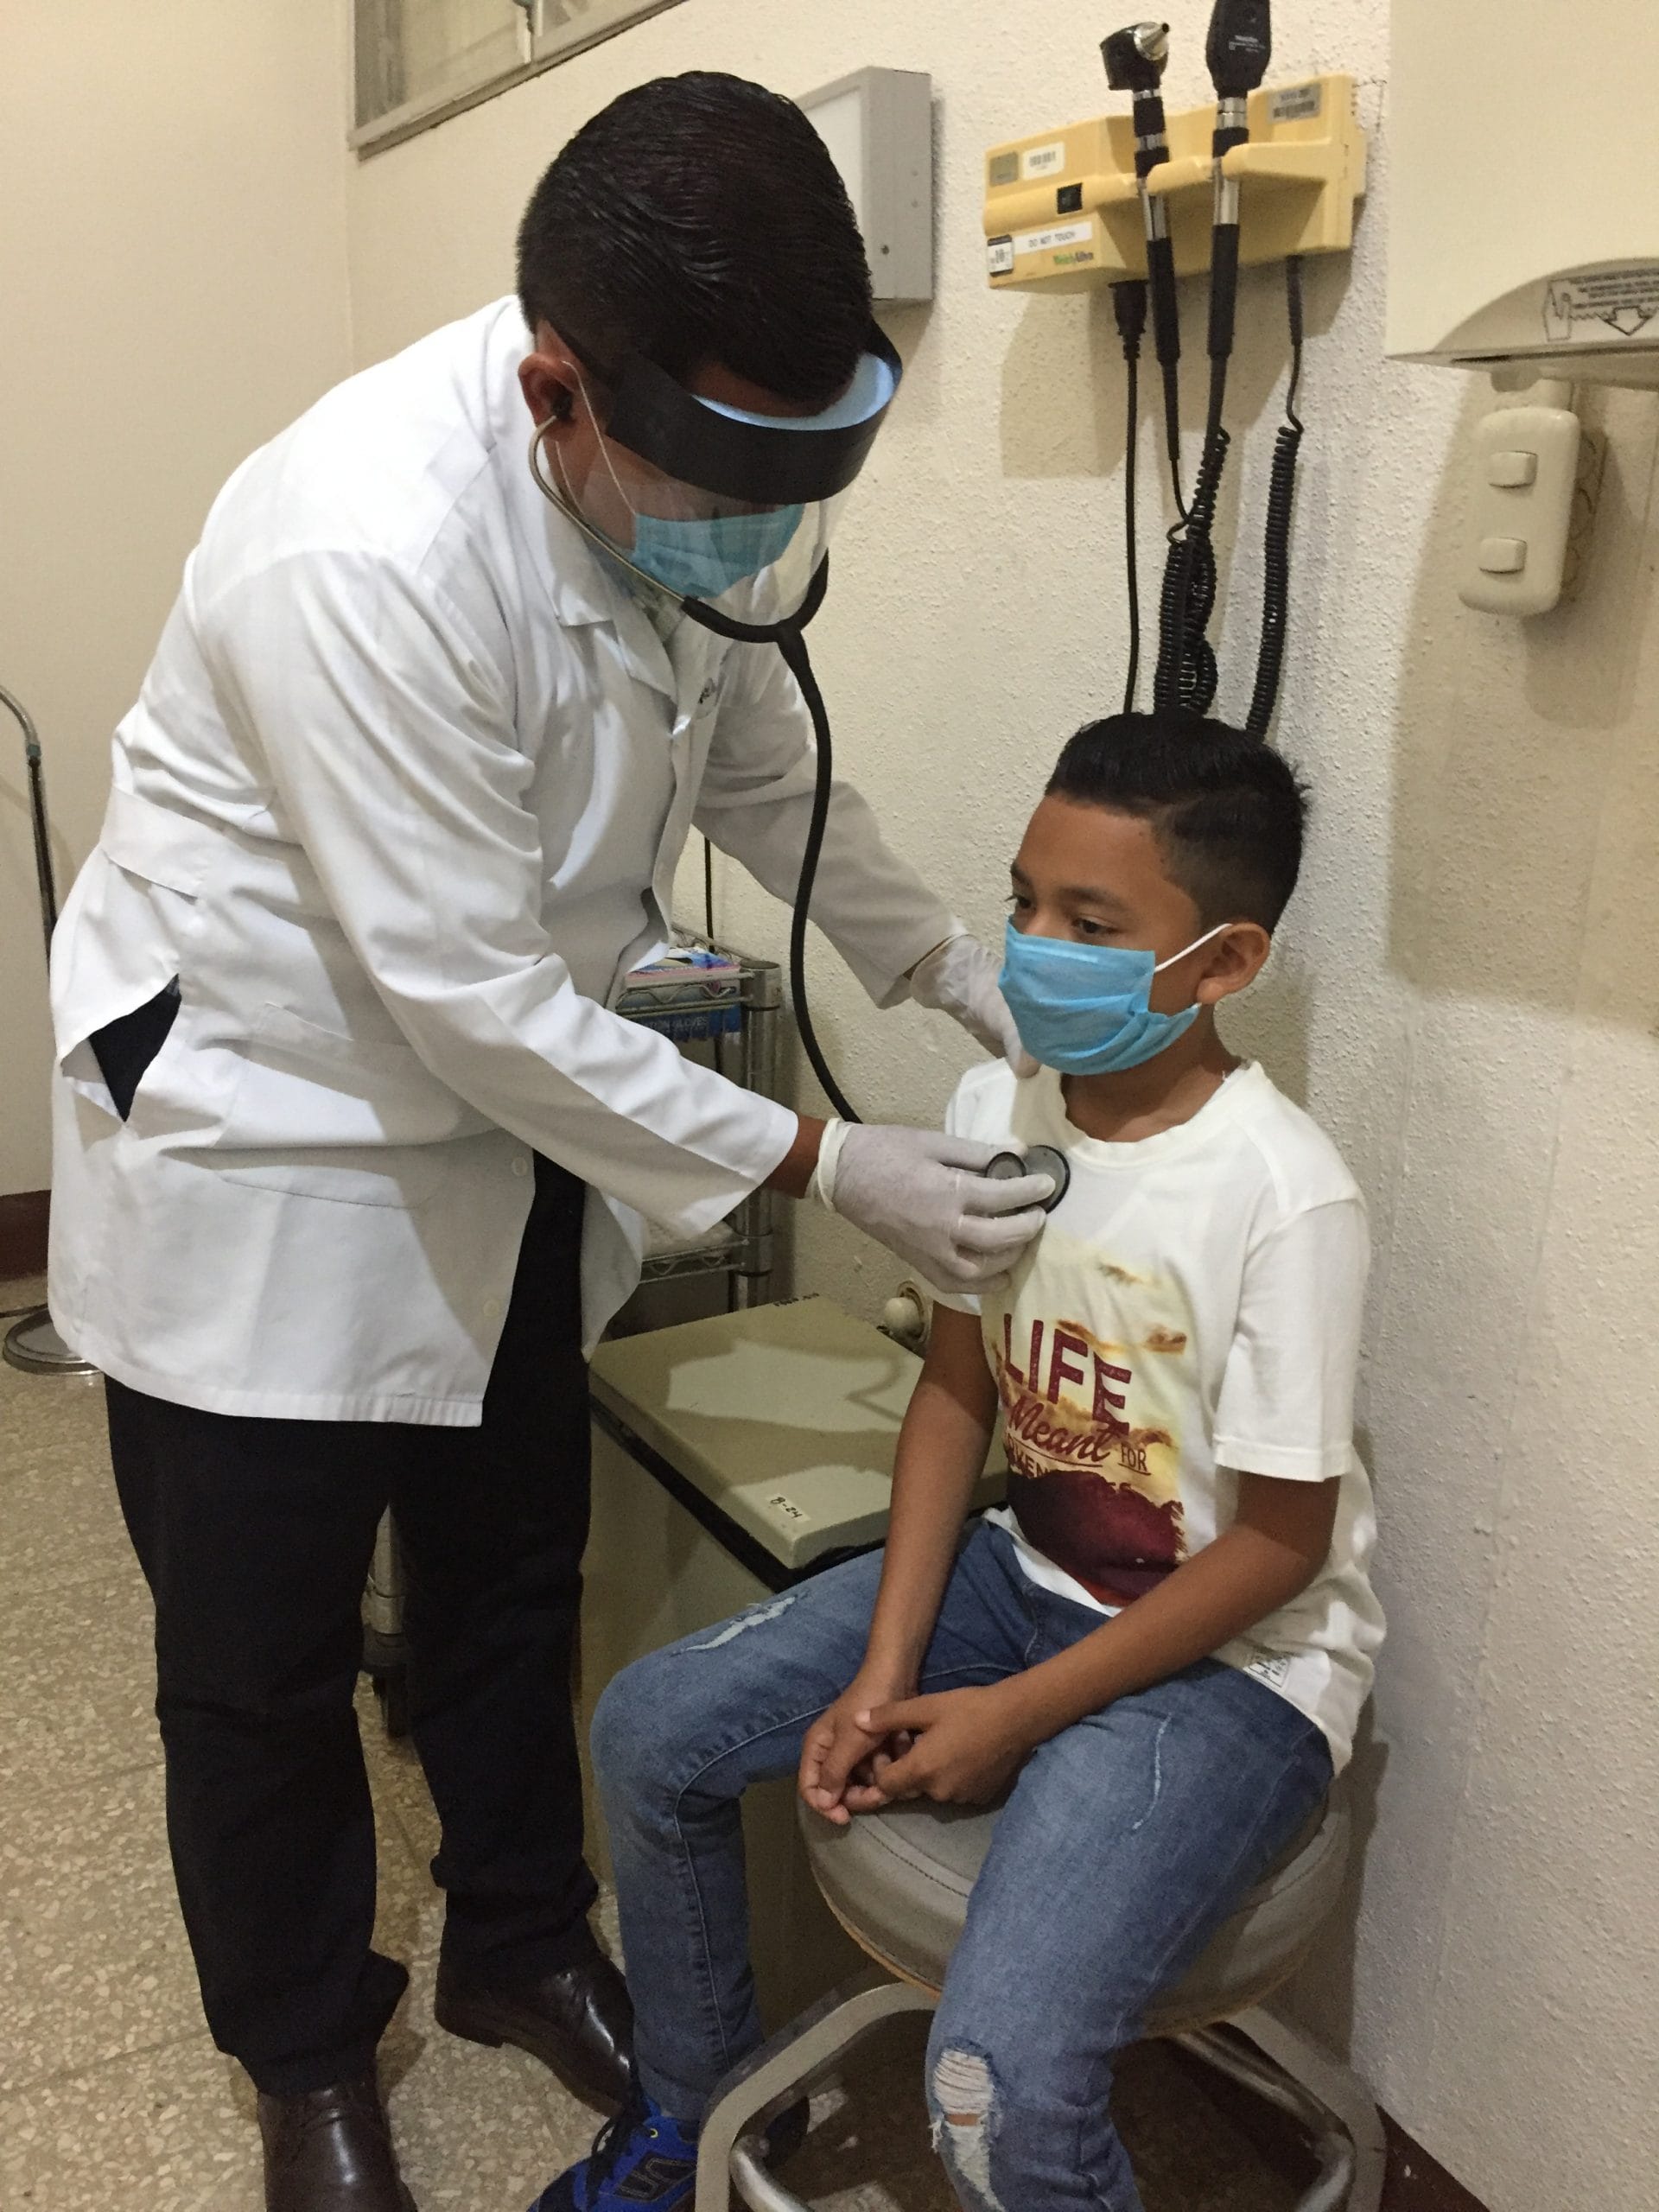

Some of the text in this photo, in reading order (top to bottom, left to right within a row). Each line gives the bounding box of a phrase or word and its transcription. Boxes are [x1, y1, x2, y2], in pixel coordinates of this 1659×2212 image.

[1003, 1313, 1132, 1435] LIFE
[1008, 1393, 1147, 1472] Meant FOR
